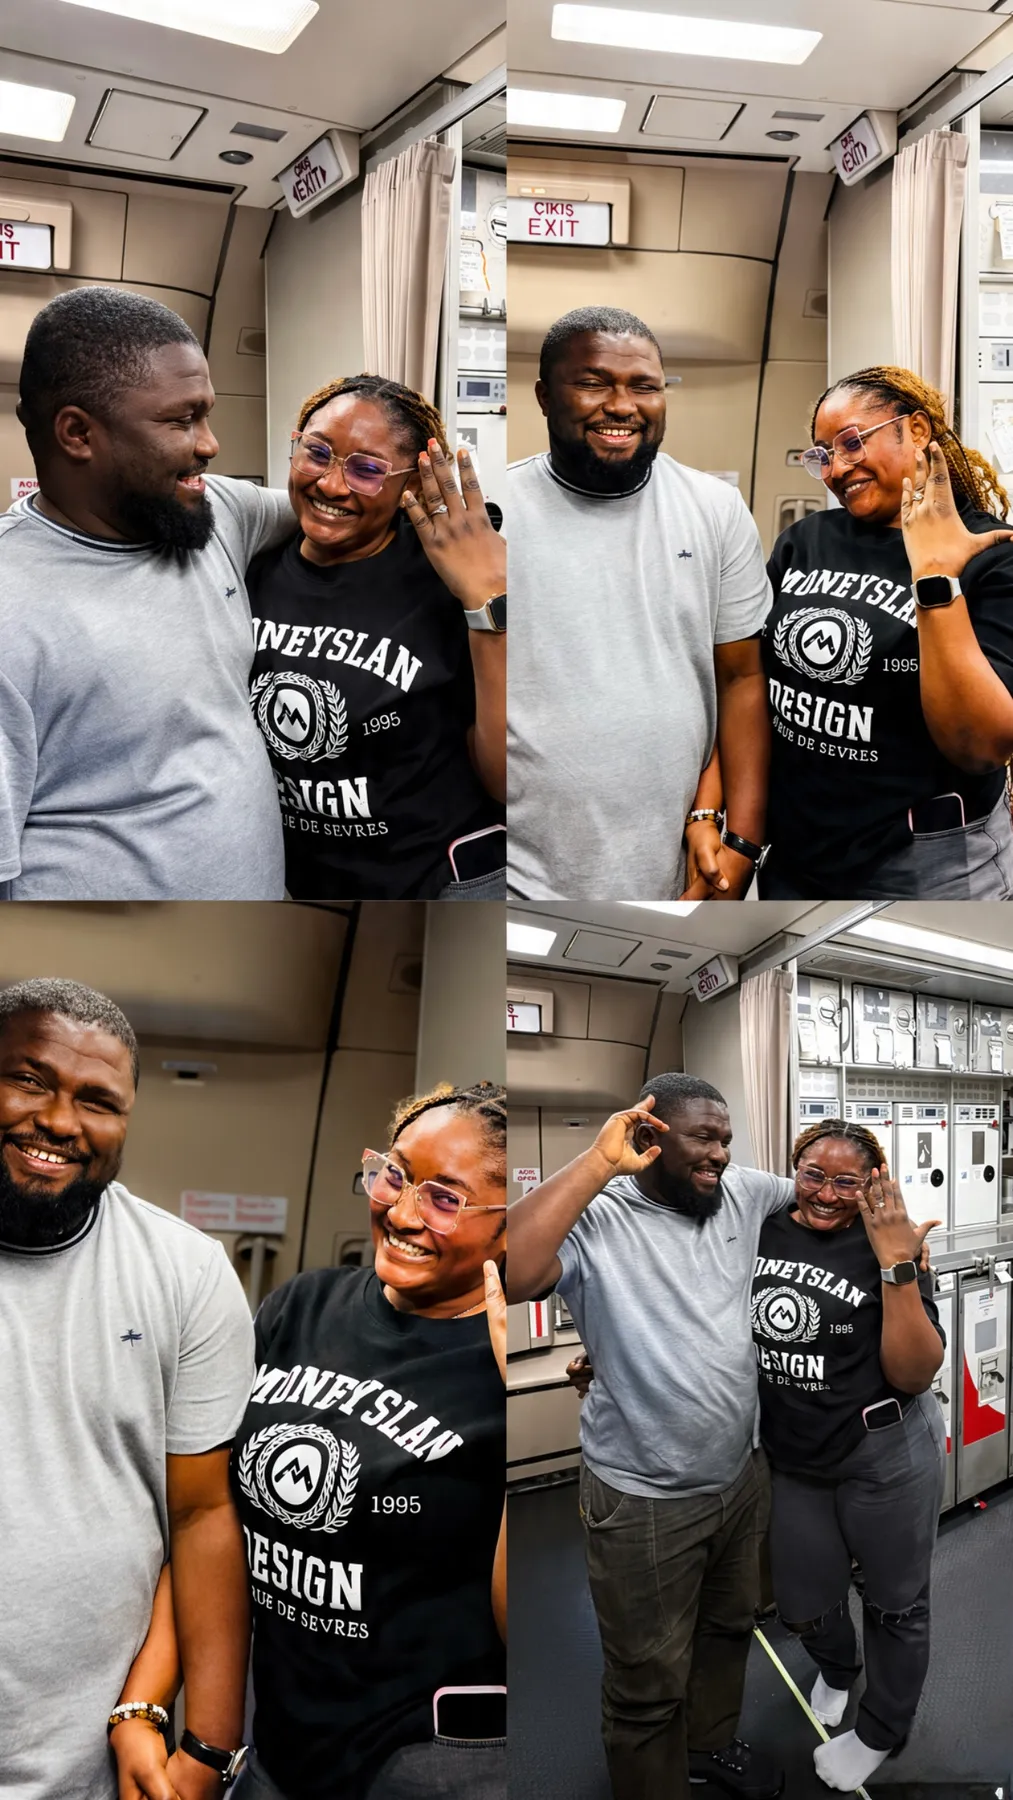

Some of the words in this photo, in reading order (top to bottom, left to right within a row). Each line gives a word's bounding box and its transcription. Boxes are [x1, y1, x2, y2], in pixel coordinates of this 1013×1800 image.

[295, 166, 322, 201] EXIT
[528, 217, 580, 237] EXIT
[882, 658, 919, 673] 1995
[769, 677, 874, 743] DESIGN
[362, 711, 401, 736] 1995
[777, 721, 794, 742] RUE
[797, 734, 815, 751] DE
[819, 741, 879, 762] SEVRES
[300, 818, 320, 834] DE
[323, 821, 389, 837] SEVRES
[829, 1323, 854, 1335] 1995
[250, 1363, 465, 1463] MONEYSLAN
[371, 1495, 422, 1514] 1995
[277, 1600, 296, 1621] DE
[300, 1611, 370, 1639] SEVRES
